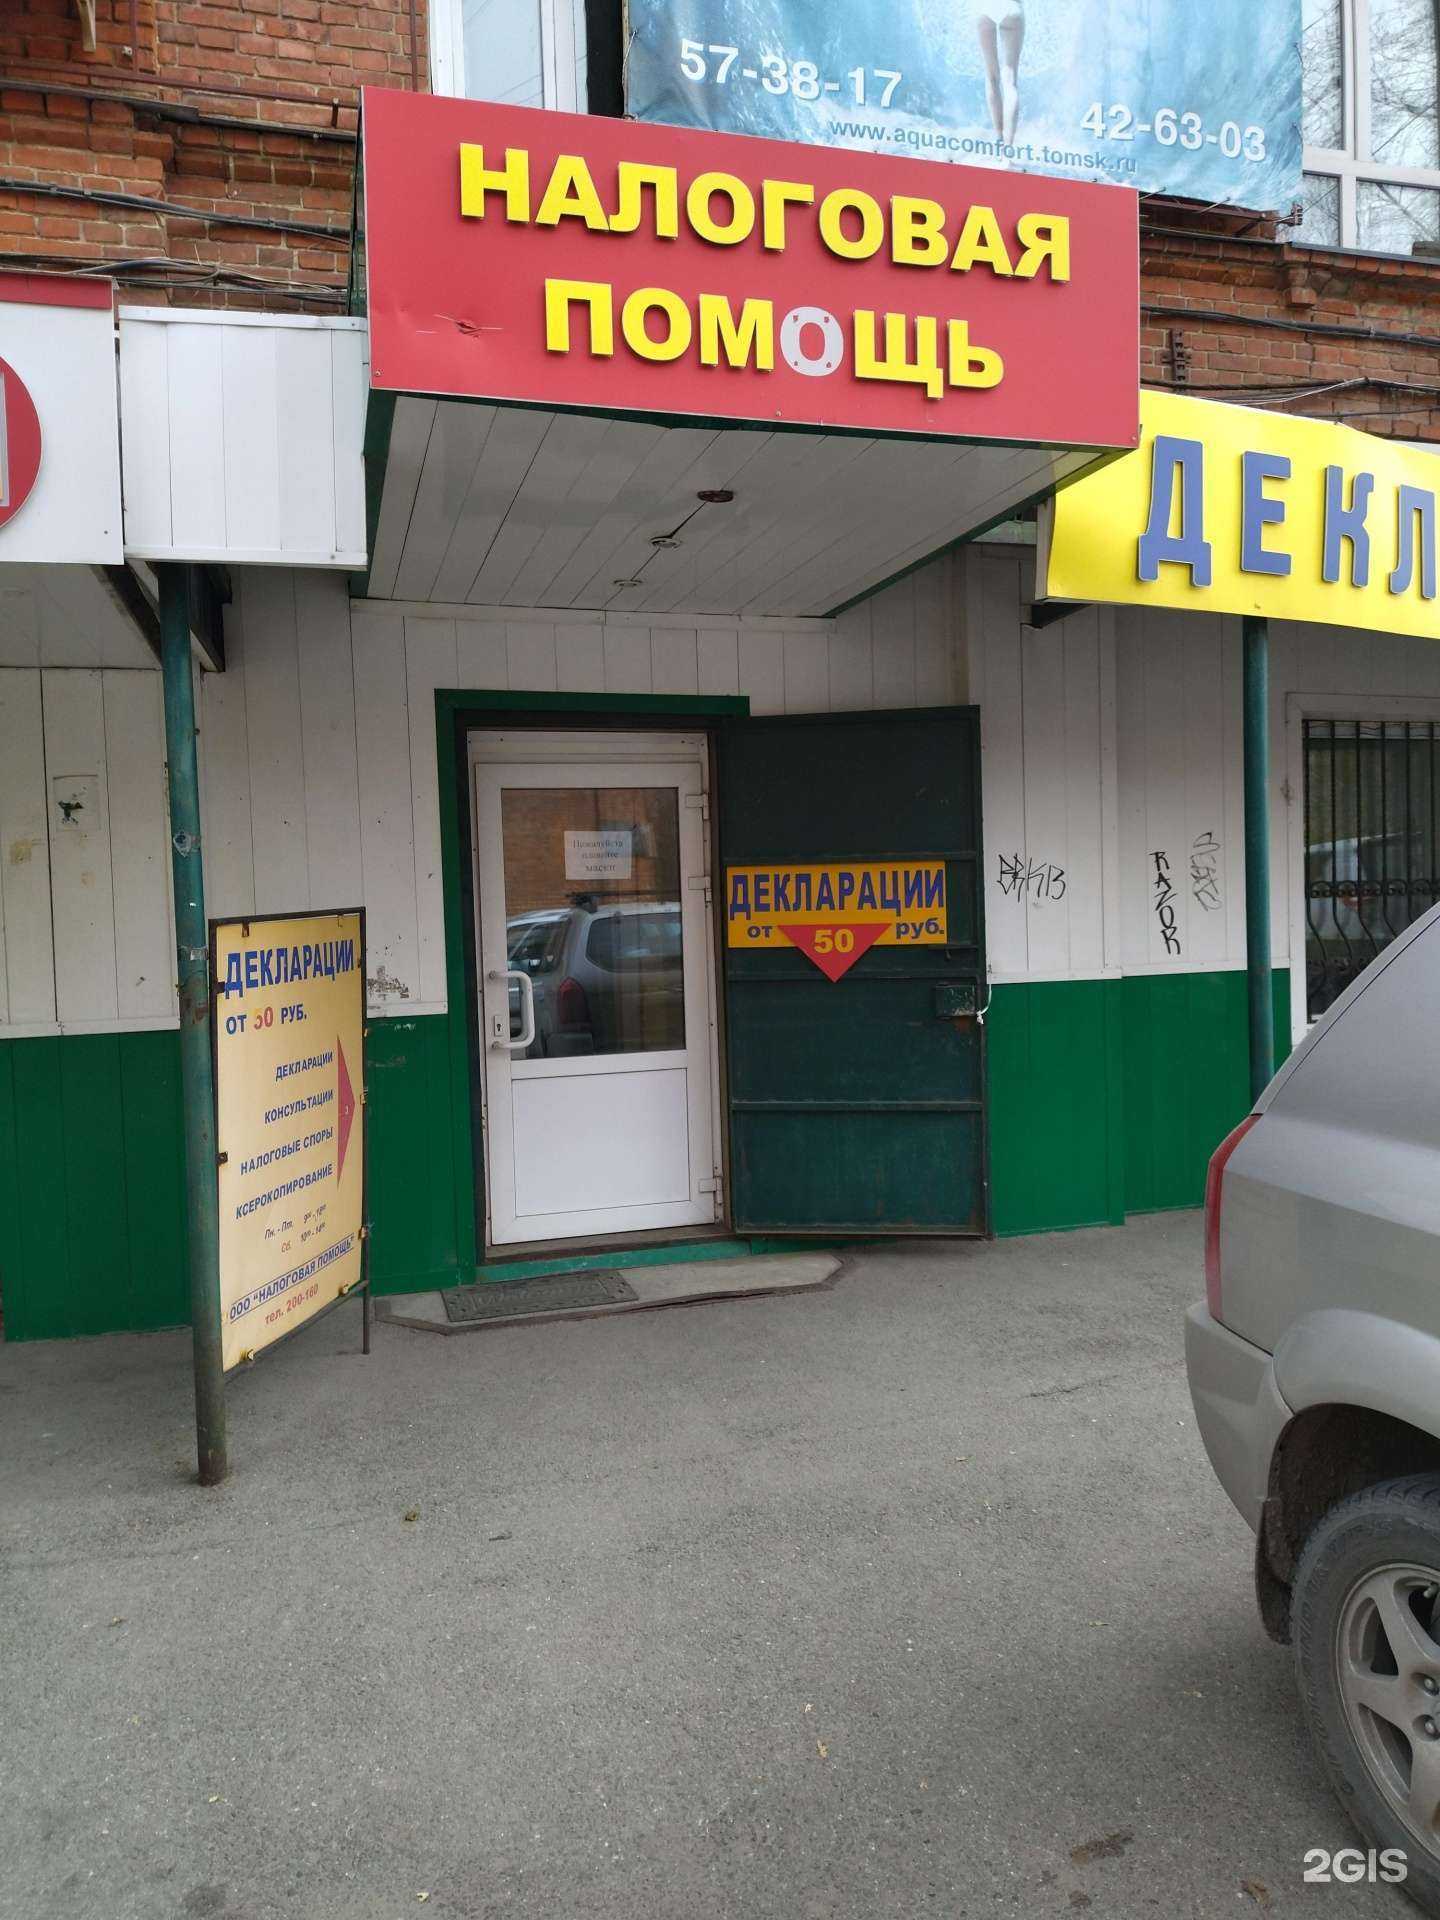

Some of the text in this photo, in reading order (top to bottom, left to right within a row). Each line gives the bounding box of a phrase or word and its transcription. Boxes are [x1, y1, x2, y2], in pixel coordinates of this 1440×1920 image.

[680, 37, 902, 108] 57-38-17
[829, 118, 1138, 174] www.aquacomfort.tomsk.ru
[1081, 102, 1266, 162] 42-63-03
[459, 142, 1071, 282] НАЛОГОВАЯ
[544, 278, 1006, 399] ПОМОЩЬ
[729, 869, 944, 920] ДЕКЛАРАЦИИ
[746, 917, 945, 955] от 50 руб.
[224, 939, 354, 999] ДЕКЛАРАЦИИ
[225, 1014, 247, 1035] ОТ
[280, 1003, 308, 1025] РУБ.
[275, 1051, 334, 1082] ДЕКЛАРАЦИИ
[264, 1089, 334, 1124] КОНСУЛЬТАЦИИ
[240, 1126, 334, 1176] НАЛОГОВЫЕ СПОРЫ
[235, 1163, 333, 1219] КСЕРОКОПИРОВАНИЕ
[229, 1298, 251, 1319] ООО
[265, 1283, 319, 1325] тел. 200-160
